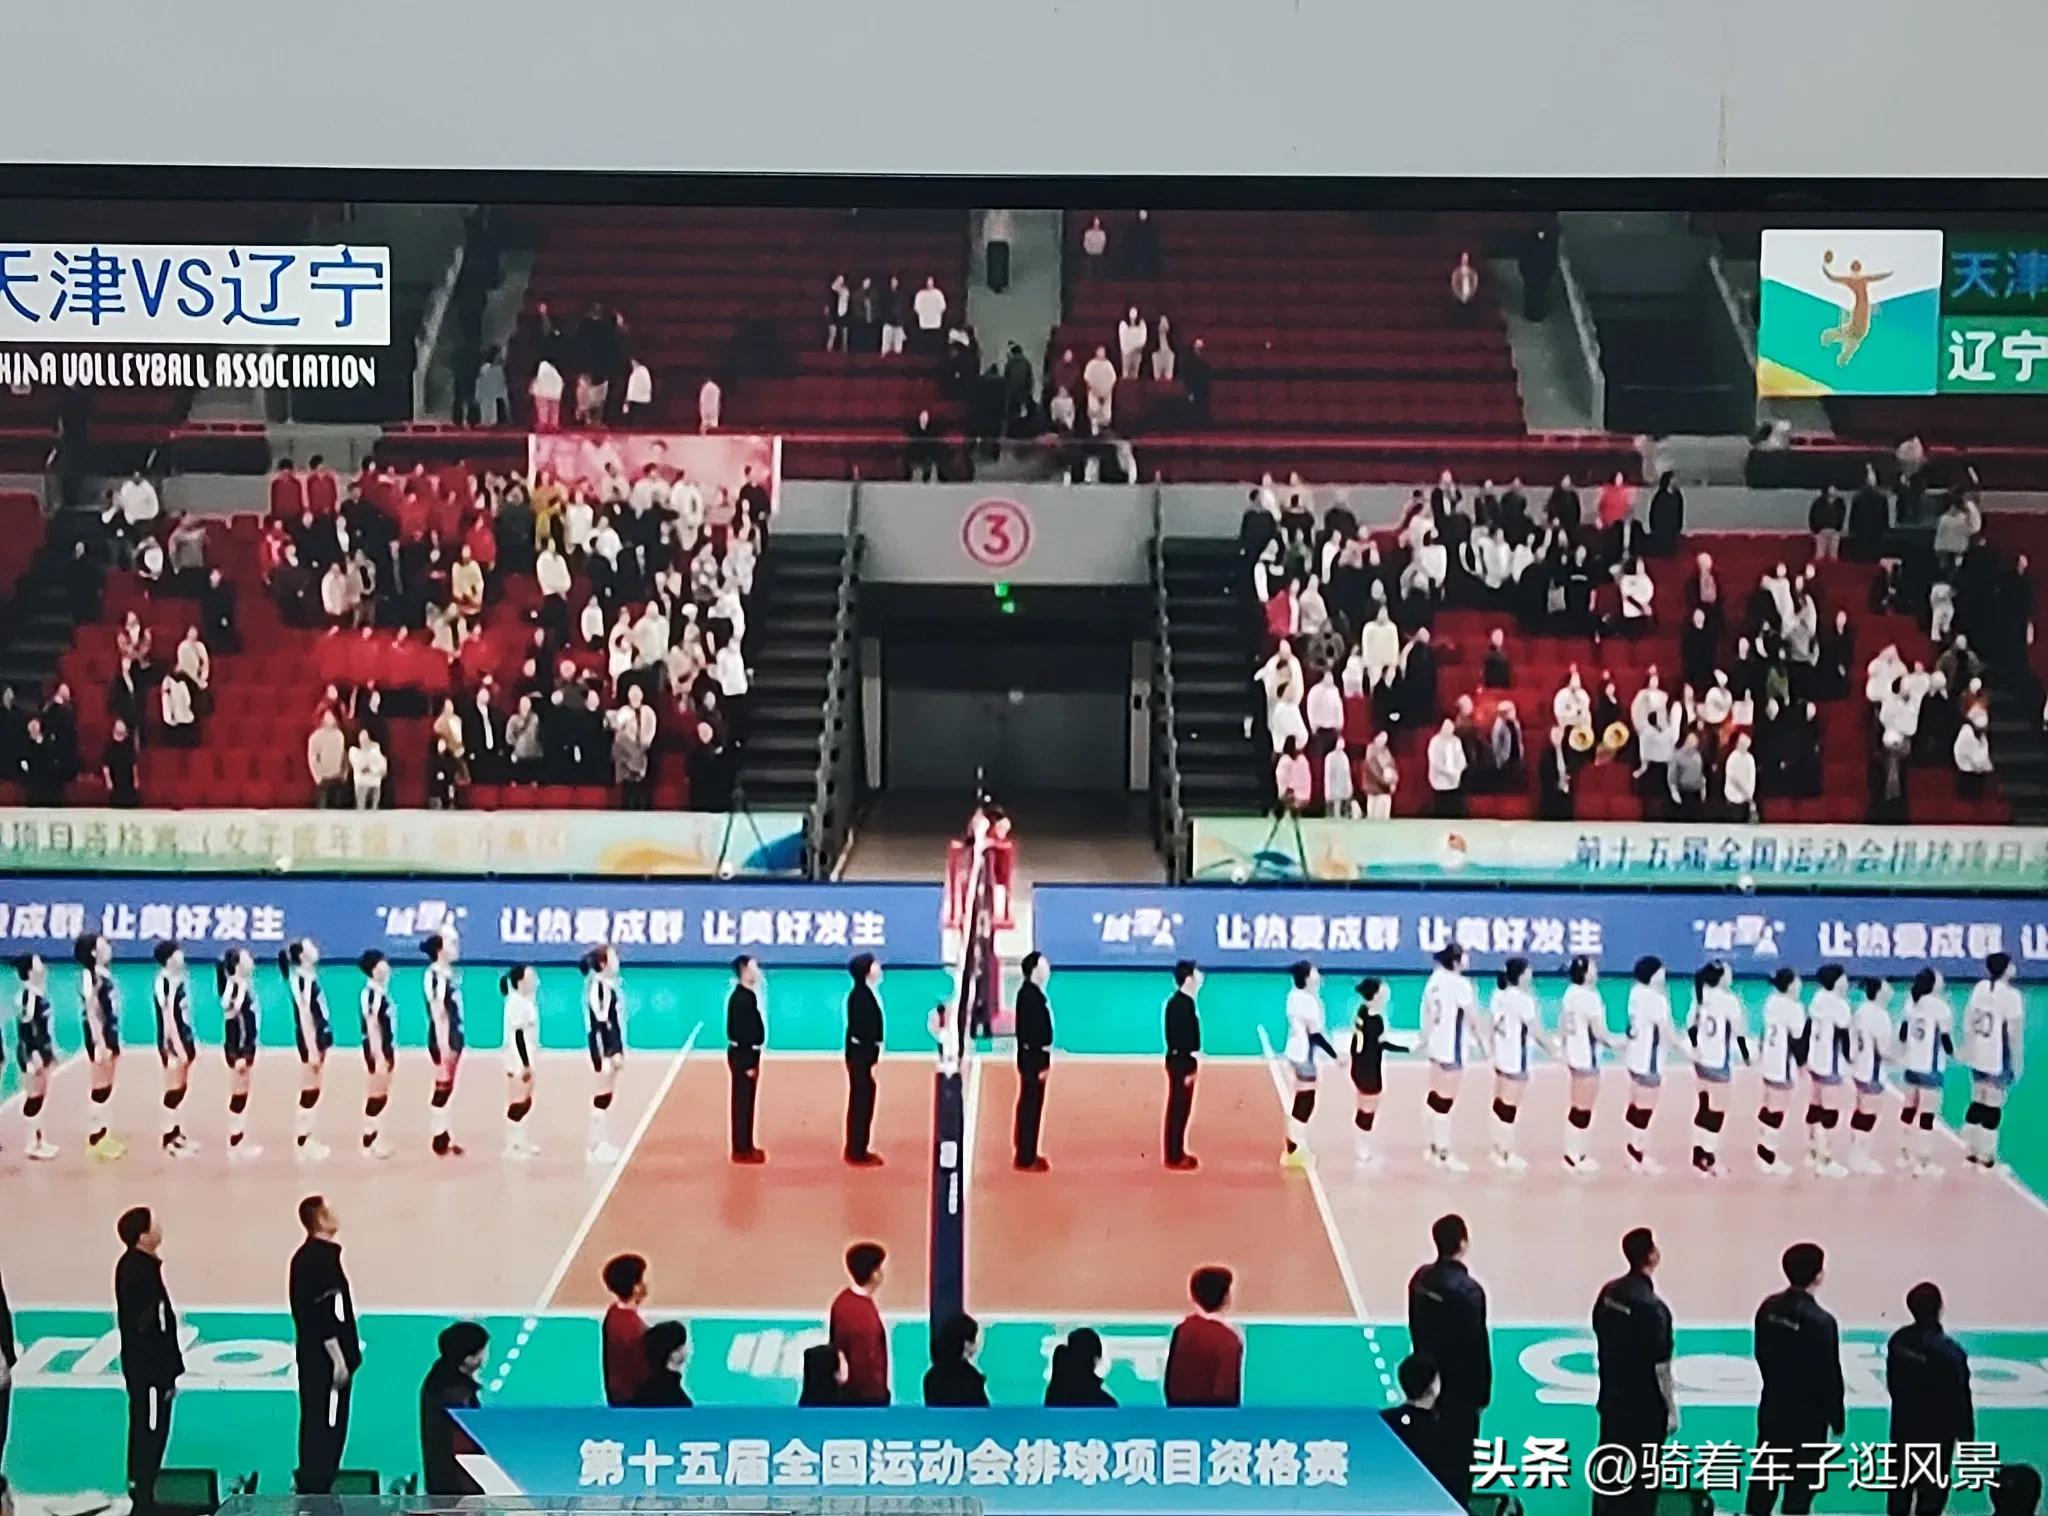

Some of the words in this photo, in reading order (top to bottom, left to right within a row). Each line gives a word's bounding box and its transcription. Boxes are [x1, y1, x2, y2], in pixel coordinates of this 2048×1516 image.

[0, 246, 384, 328] 天津VS辽宁
[1950, 250, 2048, 299] 天津
[62, 352, 209, 388] VOLLEYBALL
[216, 353, 376, 388] ASSOCIATION
[1948, 330, 2048, 382] 辽宁
[0, 903, 84, 939] 成群
[101, 903, 285, 940] 让美好发生
[500, 906, 684, 945] 让热爱成群
[702, 908, 886, 946] 让美好发生
[1216, 913, 1401, 951] 让热爱成群
[1418, 914, 1604, 954] 让美好发生
[1818, 920, 2002, 959] 让热爱成群
[578, 1438, 1349, 1487] 第十五届全国运动会排球项目资格赛
